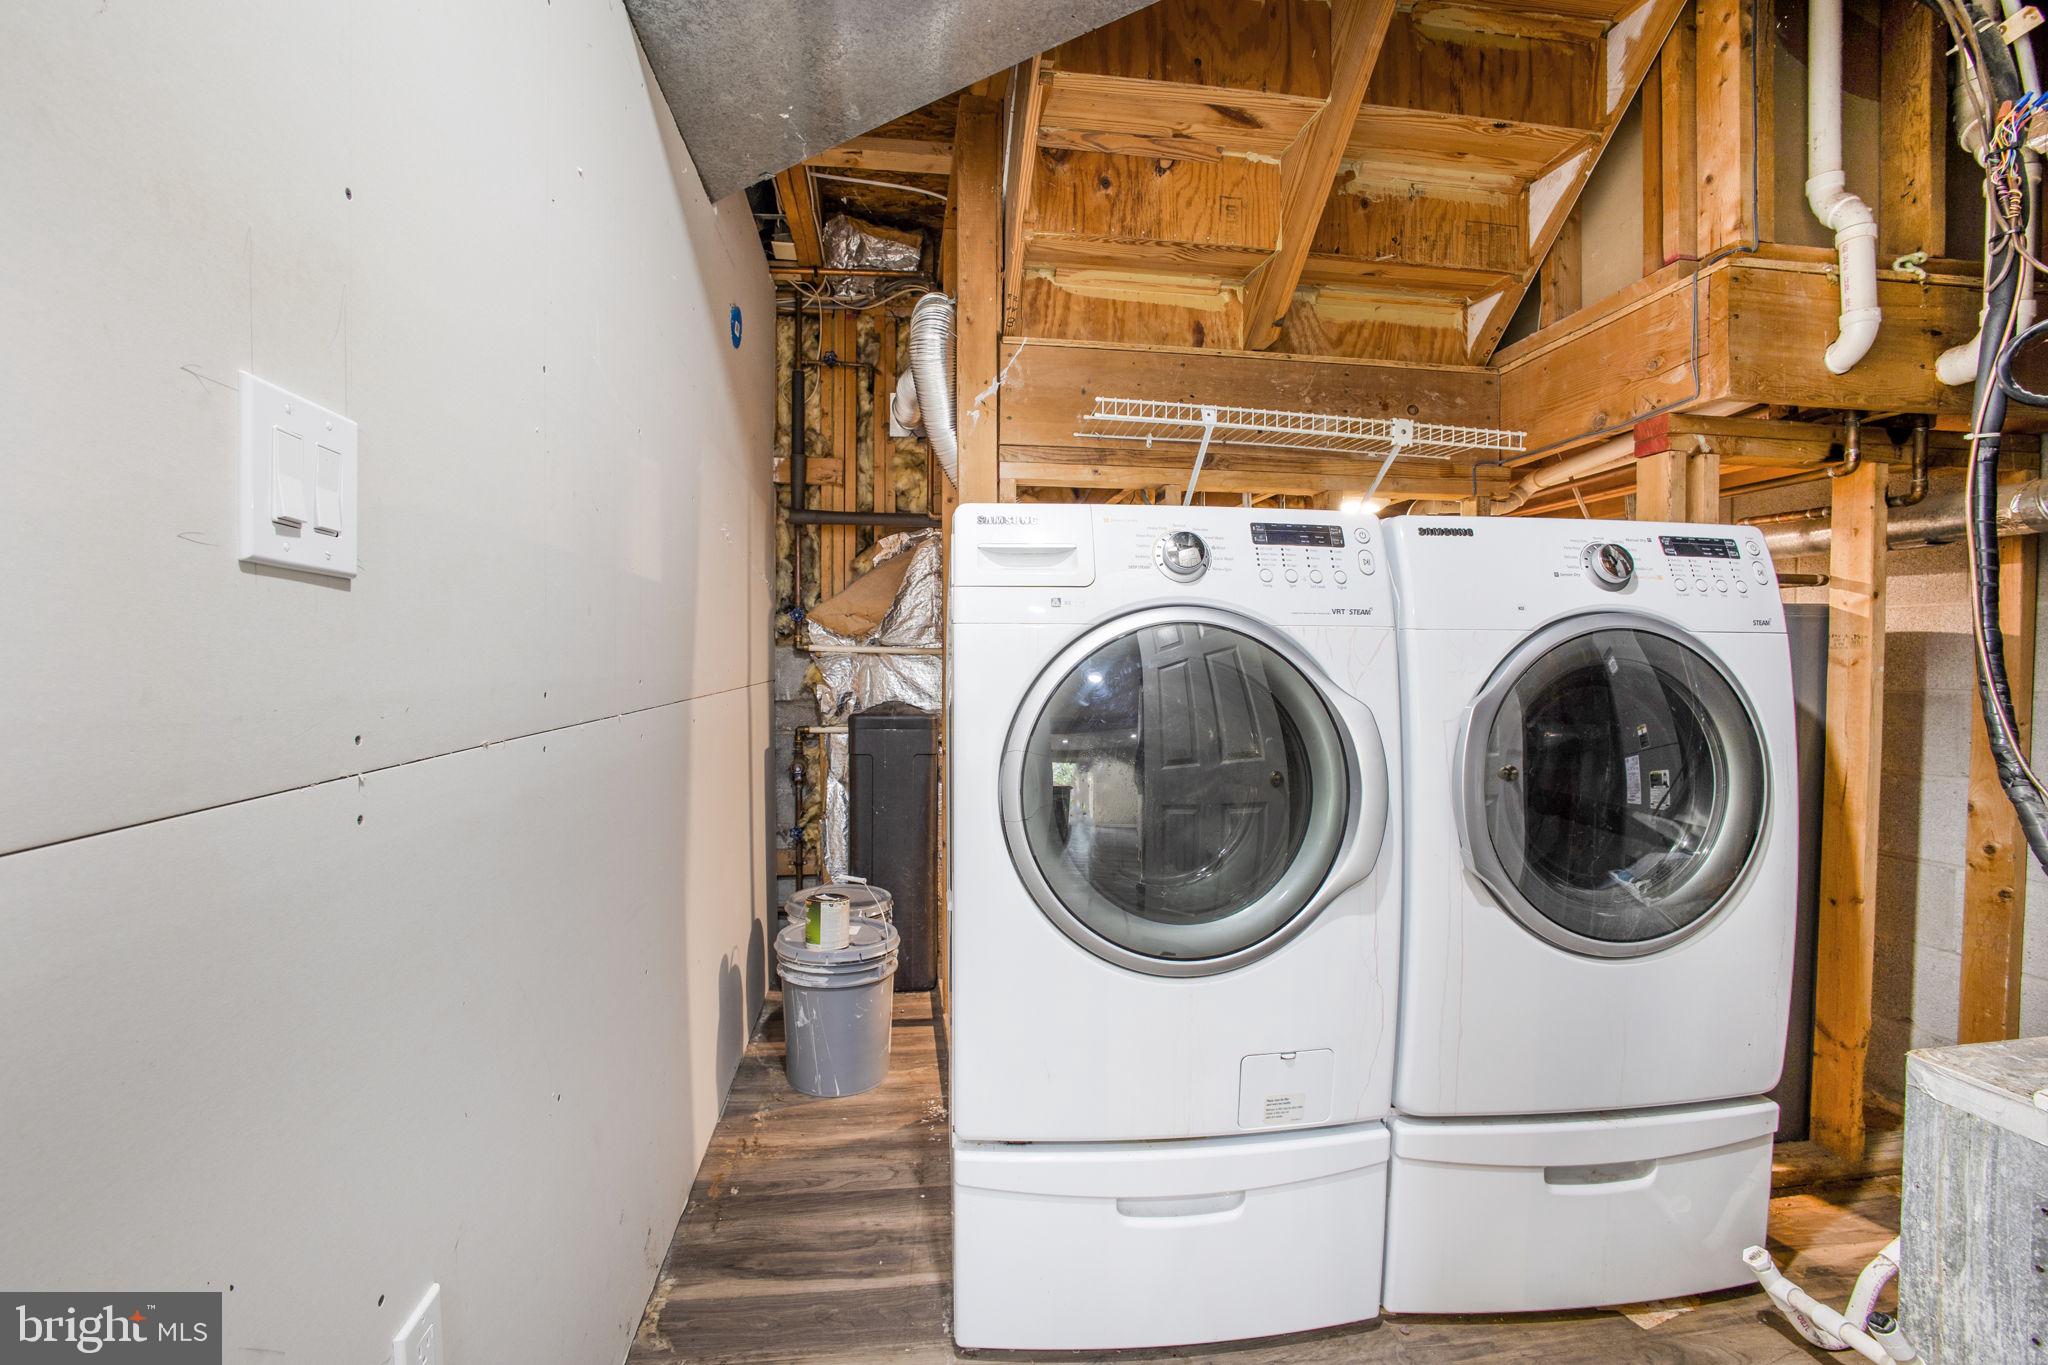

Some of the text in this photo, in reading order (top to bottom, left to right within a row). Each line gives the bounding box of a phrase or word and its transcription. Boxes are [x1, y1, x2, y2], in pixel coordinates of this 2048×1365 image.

[976, 515, 1038, 525] SAMSUNG
[1418, 527, 1474, 537] SAMSUNG
[1349, 608, 1372, 616] STEAM
